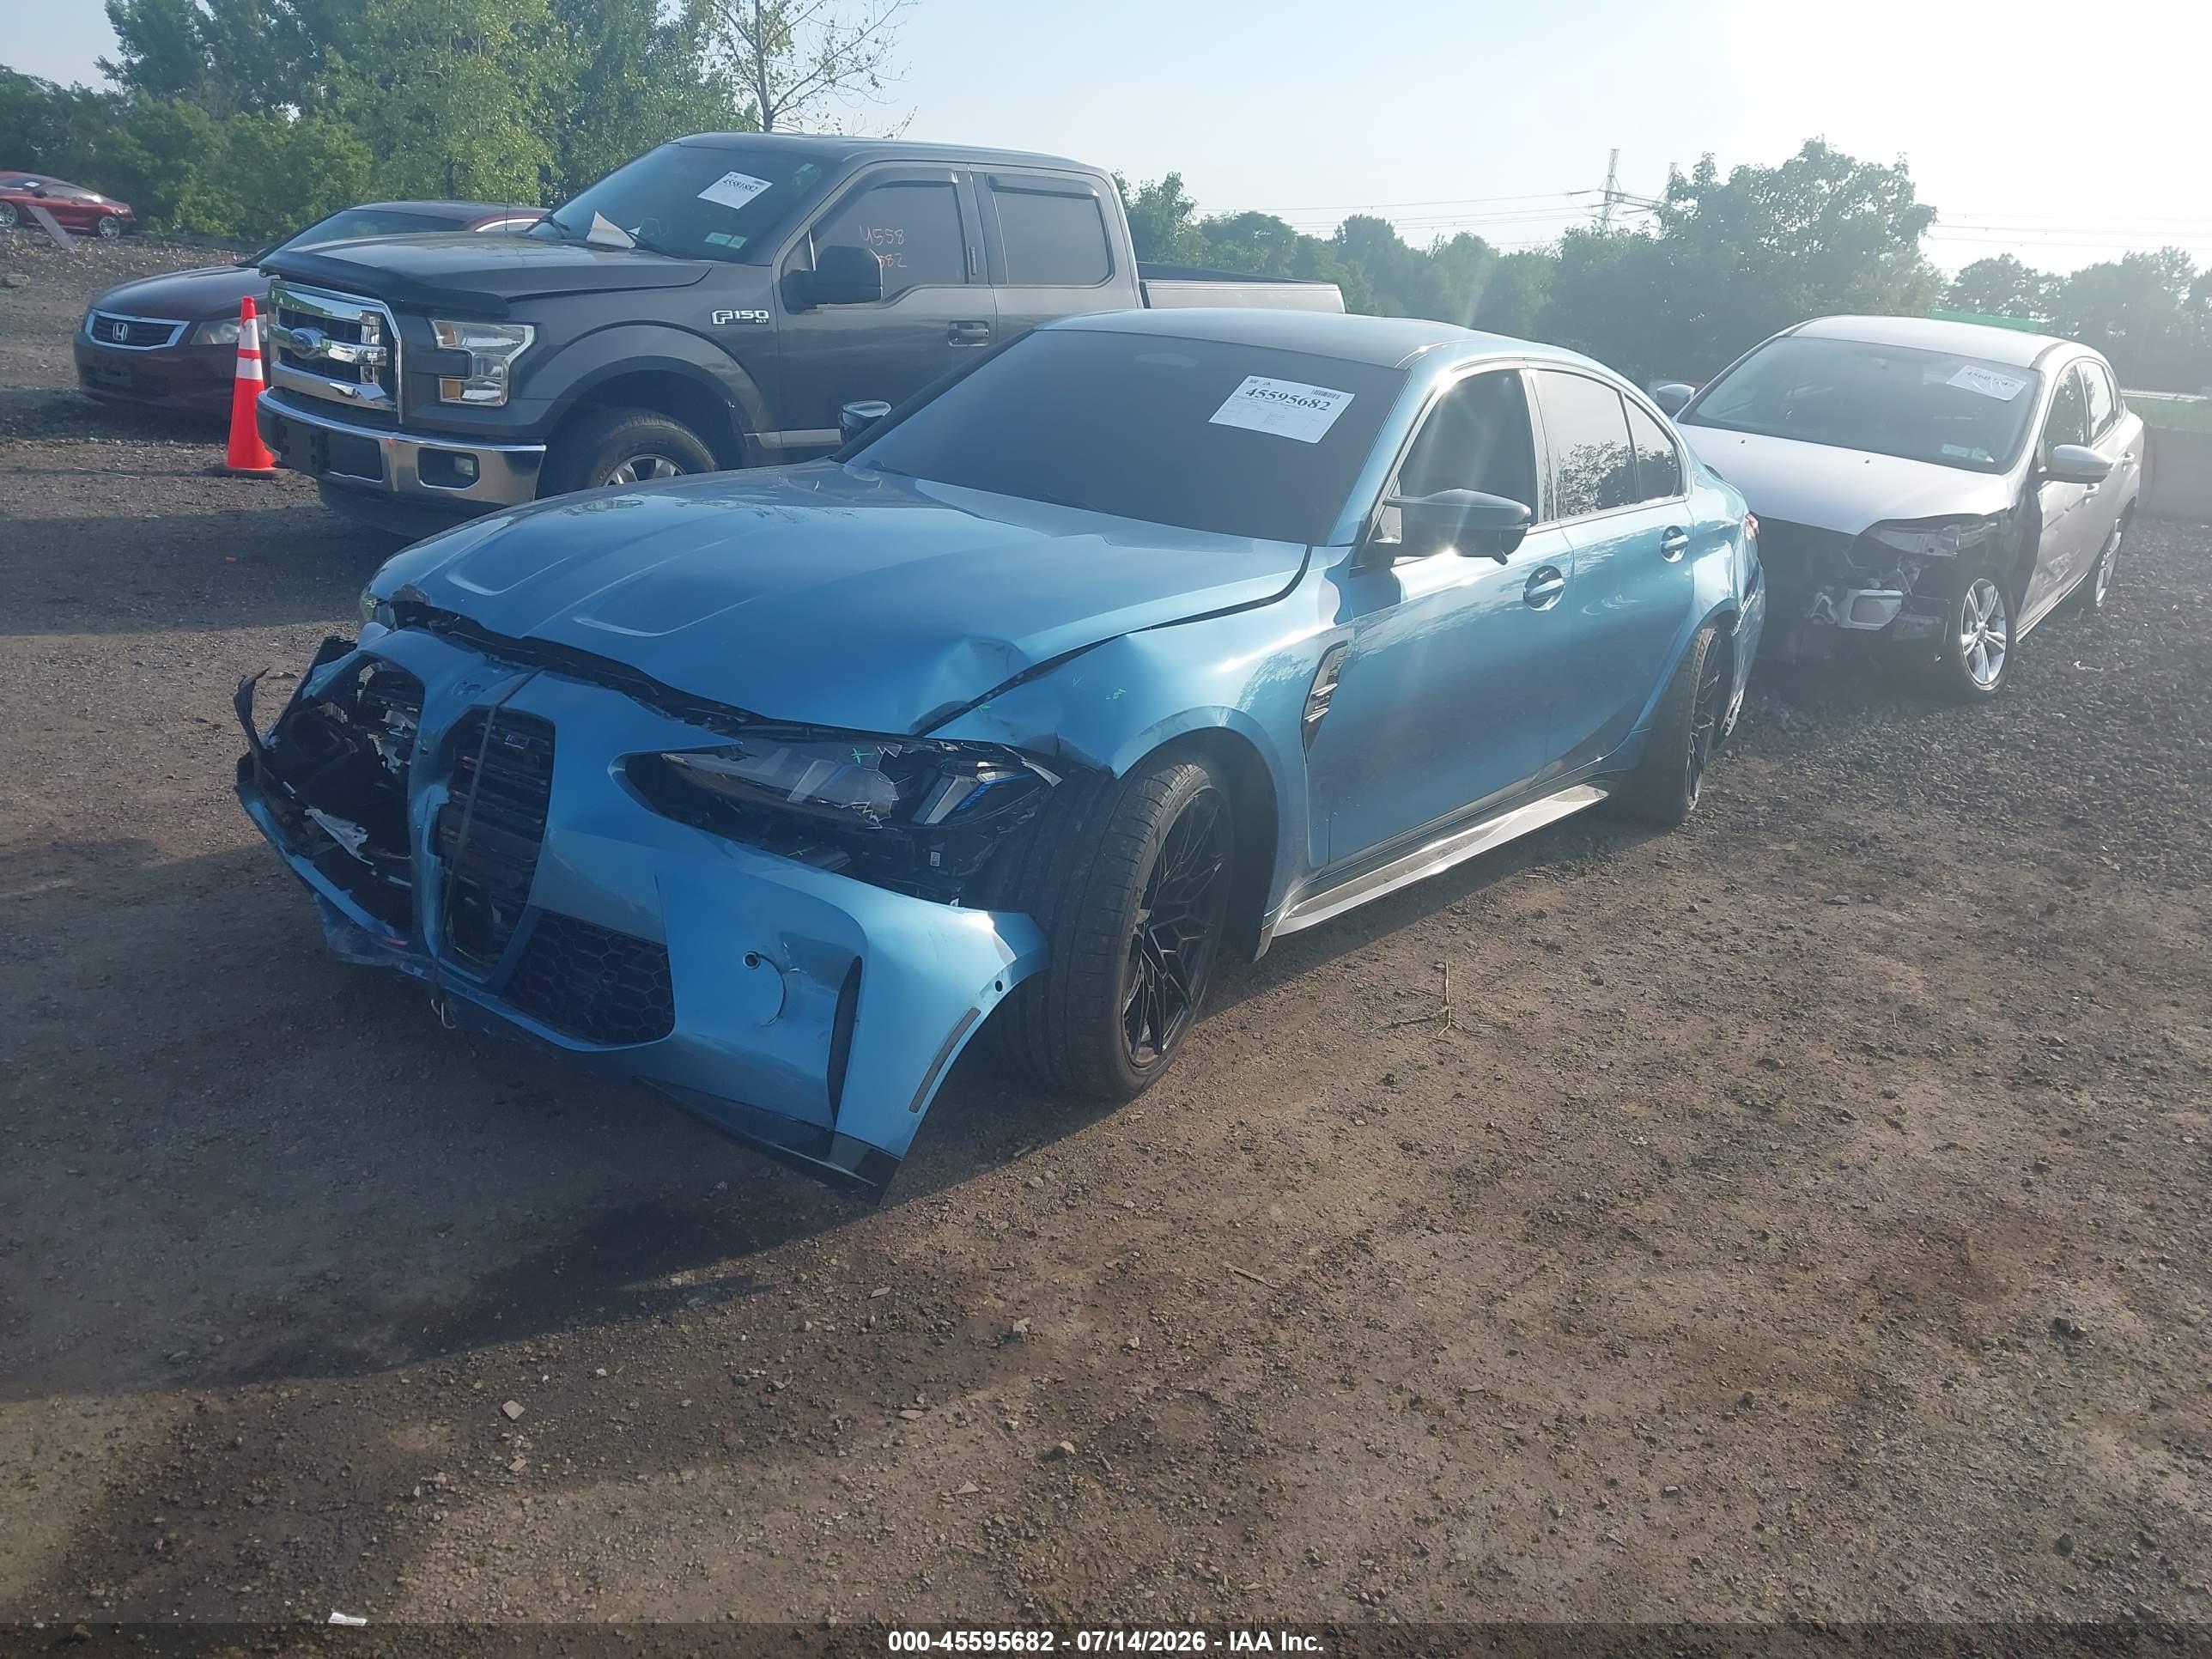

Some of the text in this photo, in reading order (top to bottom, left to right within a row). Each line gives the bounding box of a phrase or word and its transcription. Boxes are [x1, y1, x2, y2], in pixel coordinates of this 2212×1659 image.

[860, 225, 905, 246] 4558
[712, 310, 769, 325] F150
[1245, 387, 1332, 411] 45595682
